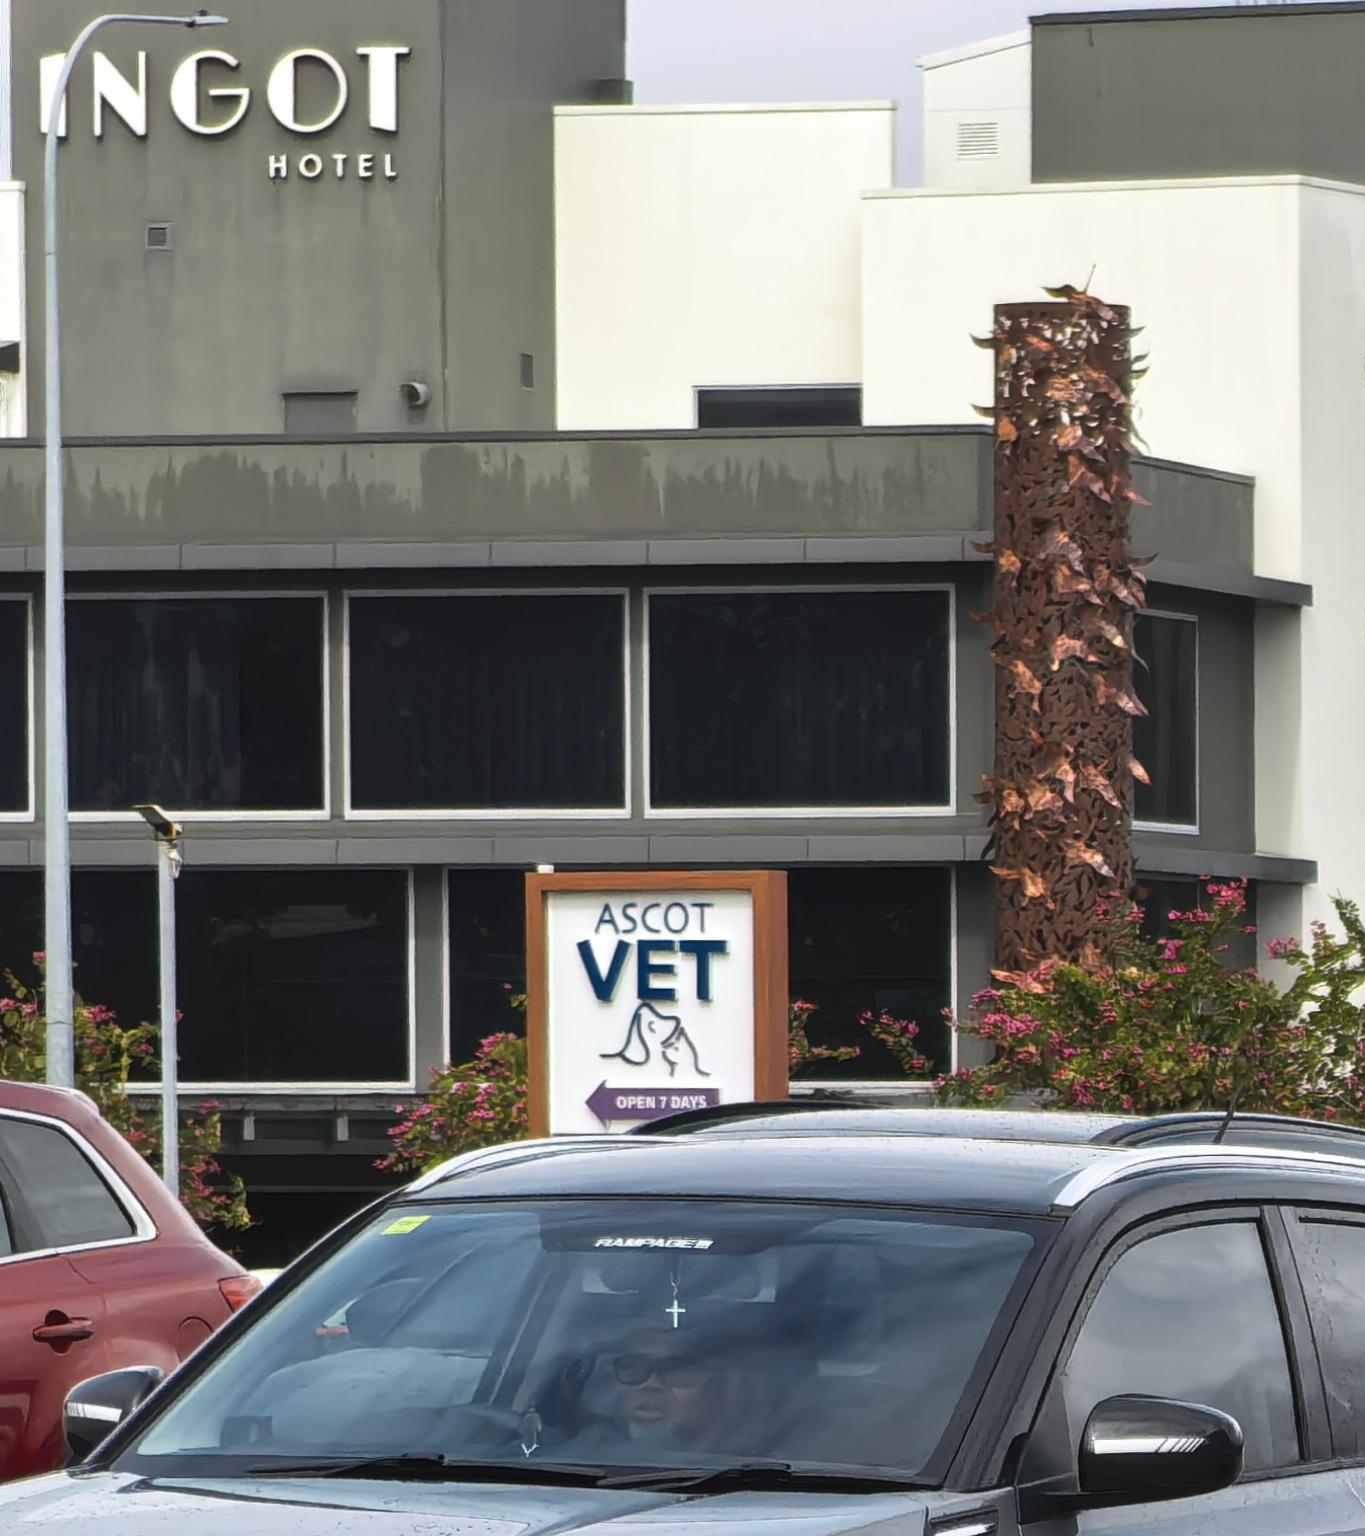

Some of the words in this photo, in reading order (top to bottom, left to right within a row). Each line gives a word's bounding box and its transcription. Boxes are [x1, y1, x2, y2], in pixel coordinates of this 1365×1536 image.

[39, 46, 411, 138] INGOT
[268, 153, 399, 180] HOTEL
[594, 902, 715, 935] ASCOT
[576, 938, 730, 1003] VET
[615, 1095, 656, 1110] OPEN
[658, 1096, 668, 1109] 7
[671, 1095, 708, 1109] DAYS
